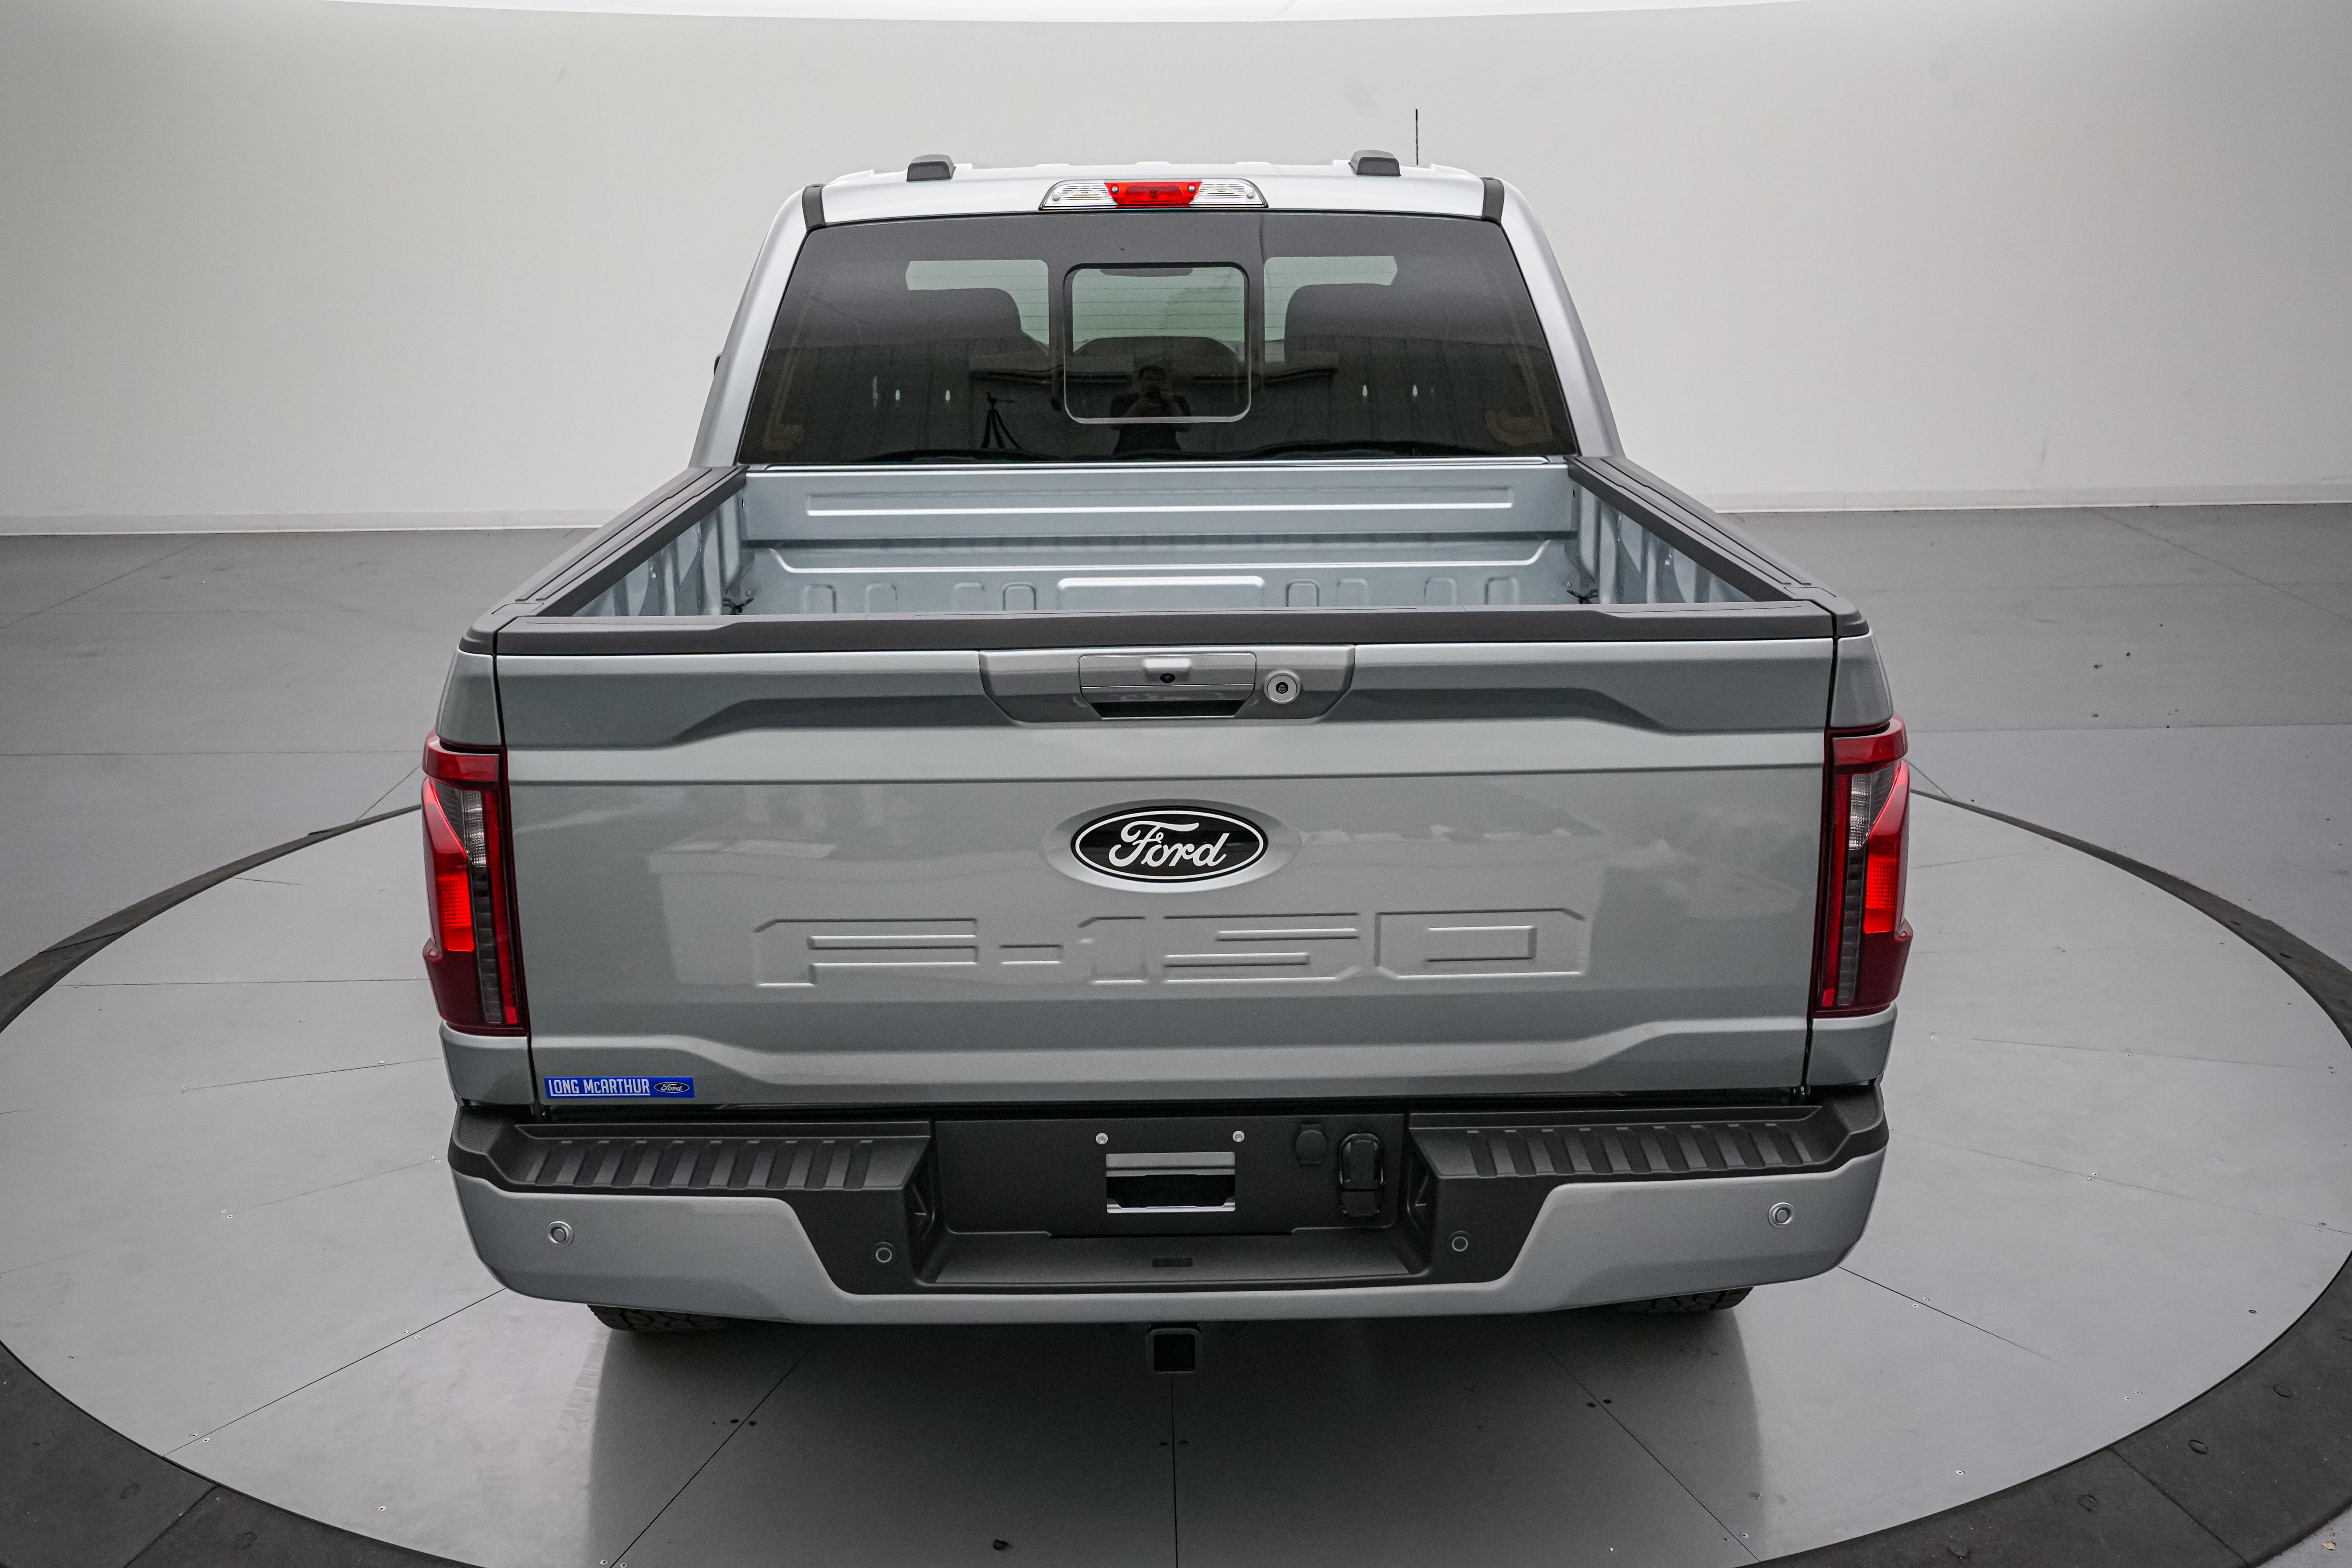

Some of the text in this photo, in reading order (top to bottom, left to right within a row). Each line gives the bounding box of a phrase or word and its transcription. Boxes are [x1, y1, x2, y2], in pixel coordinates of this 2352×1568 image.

[1108, 820, 1230, 867] Ford
[753, 908, 1587, 987] F-150
[548, 1079, 650, 1096] LONG McARTHUR
[661, 1083, 682, 1091] Ford
